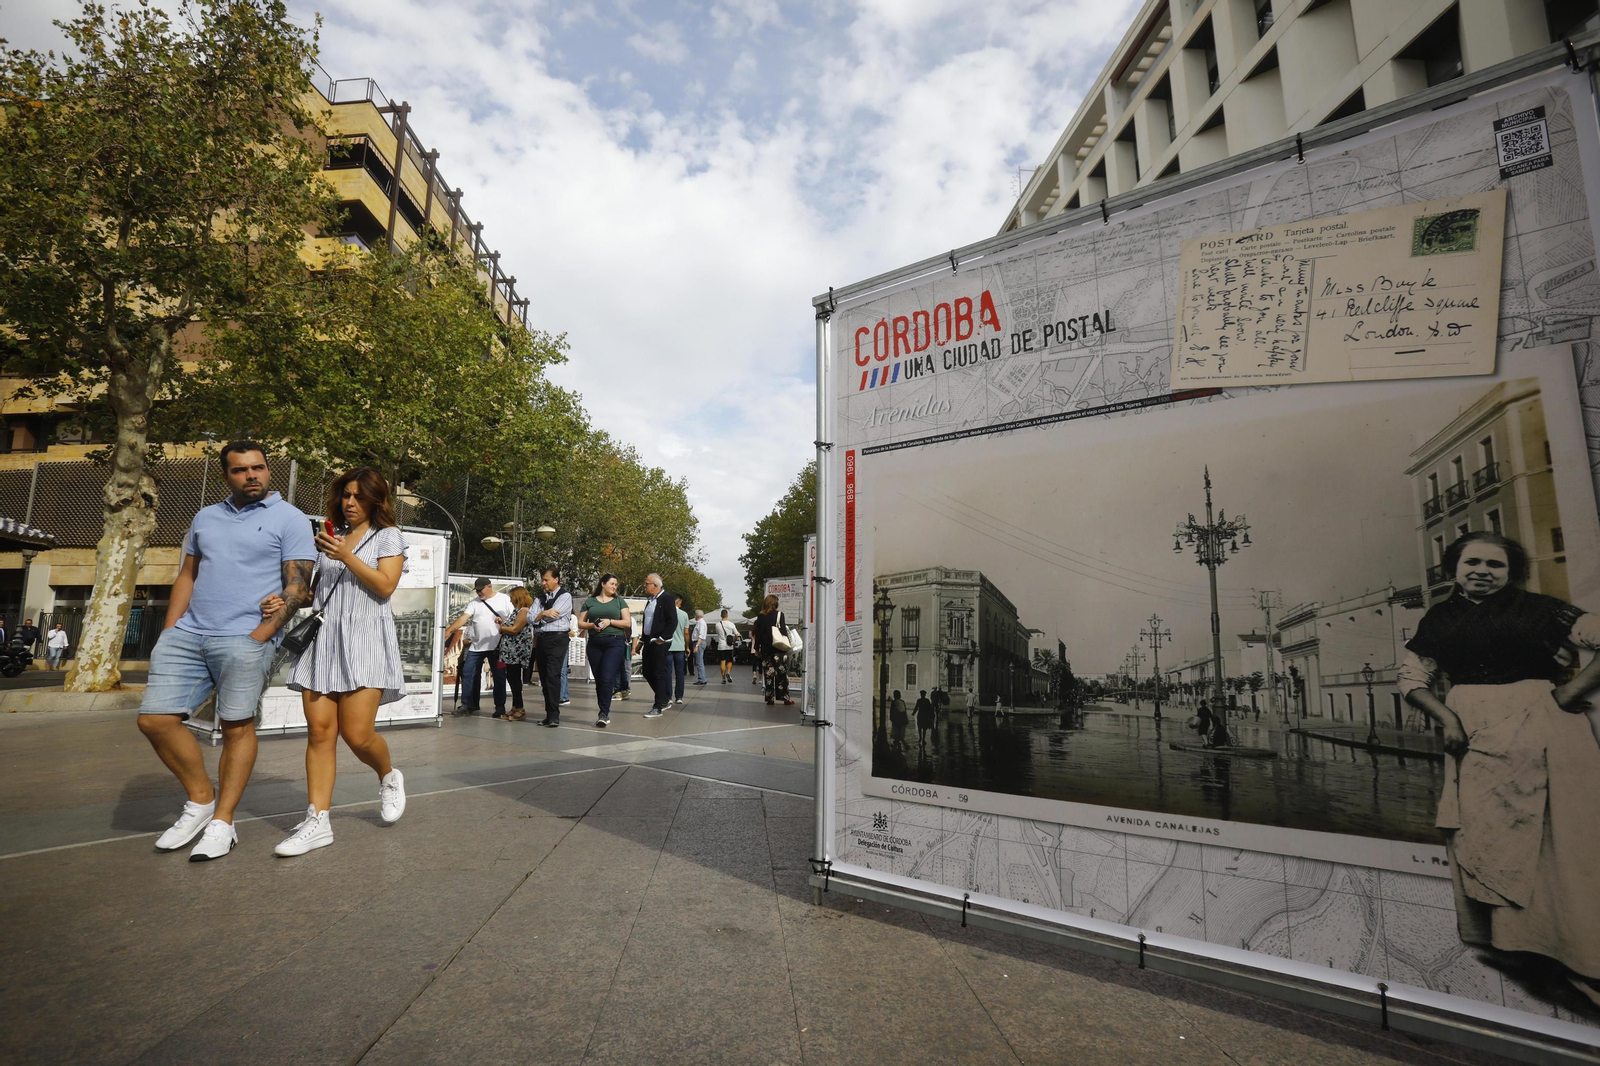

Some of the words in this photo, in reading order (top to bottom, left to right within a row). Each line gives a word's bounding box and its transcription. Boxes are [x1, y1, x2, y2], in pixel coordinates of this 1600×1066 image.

[1501, 115, 1538, 128] MUNICIPAL
[1504, 110, 1534, 124] ARCHIVO
[1505, 162, 1533, 172] ESCANEA
[1534, 156, 1550, 165] PARA
[1511, 167, 1531, 176] SABER
[1200, 238, 1234, 250] POST
[1284, 226, 1315, 239] Tarjeta
[1320, 222, 1349, 234] postal.
[1216, 248, 1230, 256] card
[1240, 244, 1257, 252] Carte
[1259, 240, 1282, 250] postale
[1292, 235, 1324, 244] Postkarte
[1336, 230, 1368, 238] Cartolina
[1370, 225, 1396, 234] postale
[854, 290, 1002, 366] CÓRDOBA
[904, 354, 935, 380] UNA
[943, 338, 1001, 370] CIUDAD
[1011, 329, 1034, 355] DE
[1043, 310, 1116, 348] POSTAL
[861, 394, 954, 430] Avenidas
[1041, 416, 1058, 424] derecha
[1065, 412, 1081, 420] aprecia
[846, 455, 854, 476] 1960
[846, 483, 854, 504] 1896
[892, 784, 938, 798] CÓRDOBA
[1106, 815, 1150, 827] AVENIDA
[1155, 820, 1220, 836] CANALEJAS
[858, 838, 880, 848] Delegación
[887, 844, 904, 854] Cultura
[883, 834, 889, 843] DE
